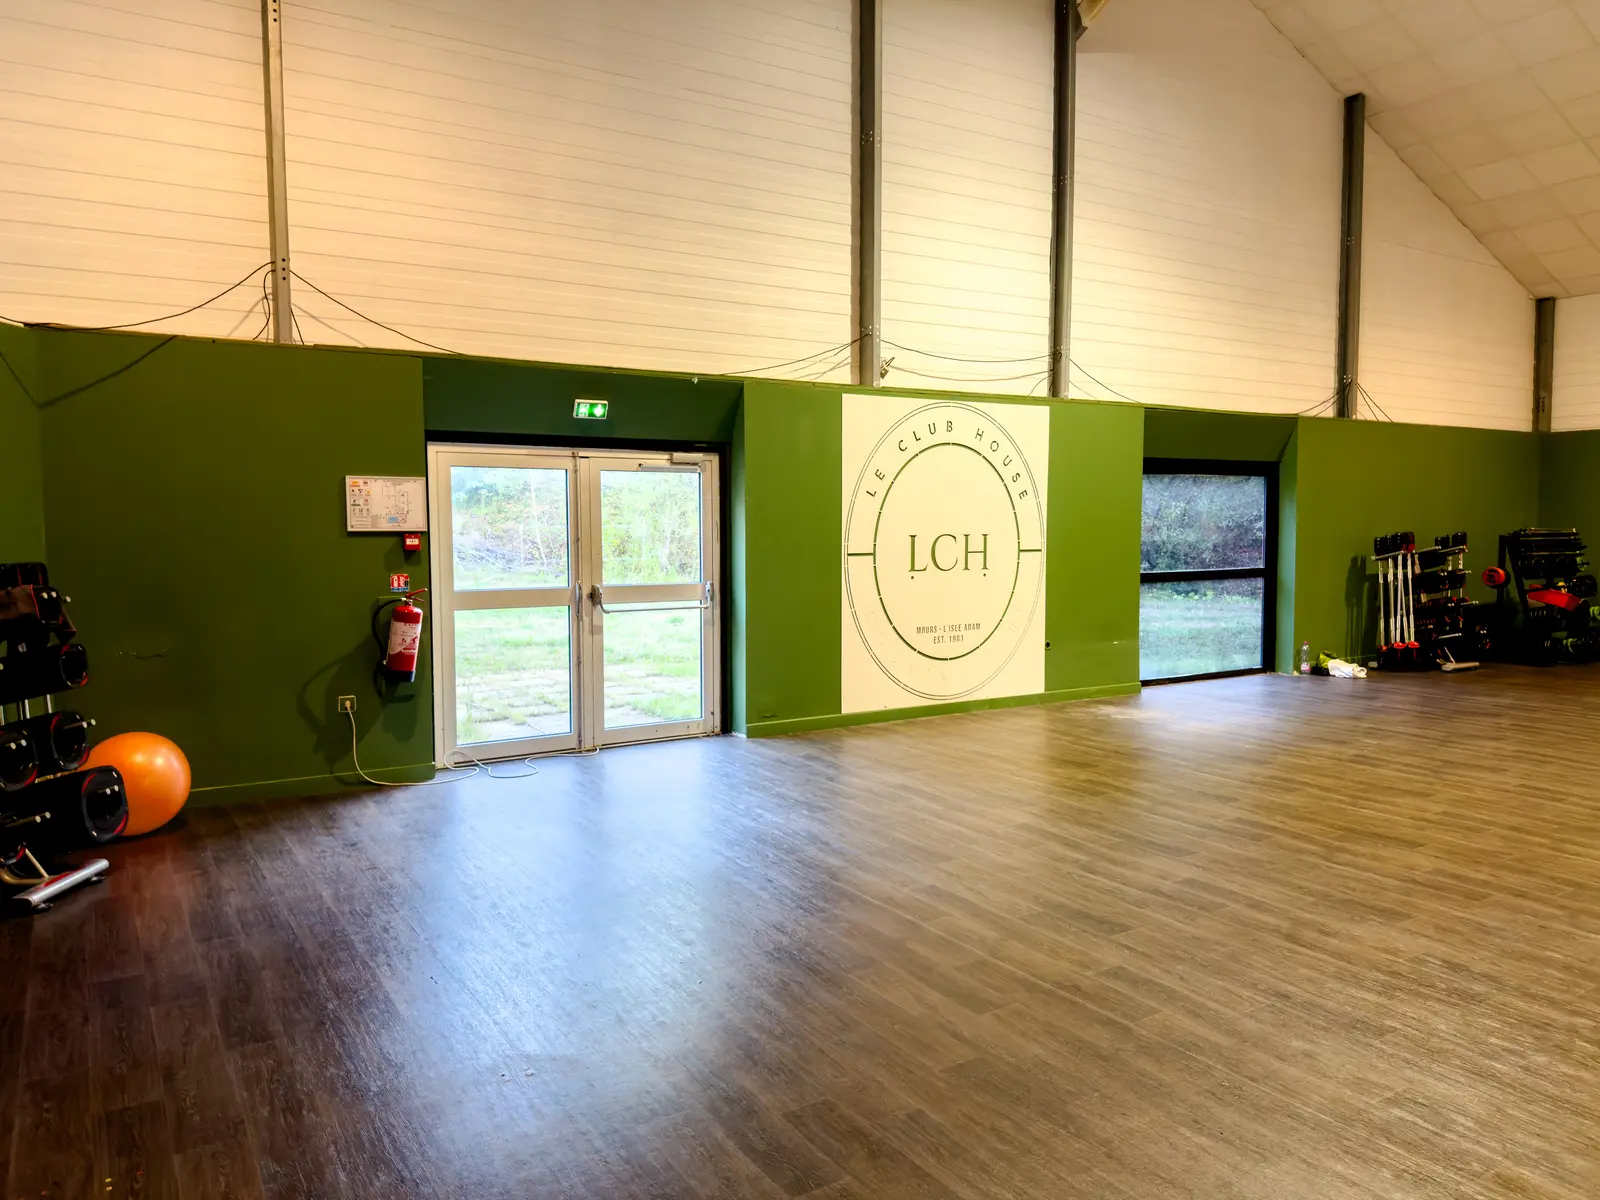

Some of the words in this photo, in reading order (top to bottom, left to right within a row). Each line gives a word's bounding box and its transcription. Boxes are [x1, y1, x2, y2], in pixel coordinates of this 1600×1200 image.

[866, 469, 886, 498] LE
[898, 420, 953, 452] CLUB
[974, 428, 1029, 500] HOUSE
[908, 533, 990, 574] LCH
[933, 635, 946, 644] EST.
